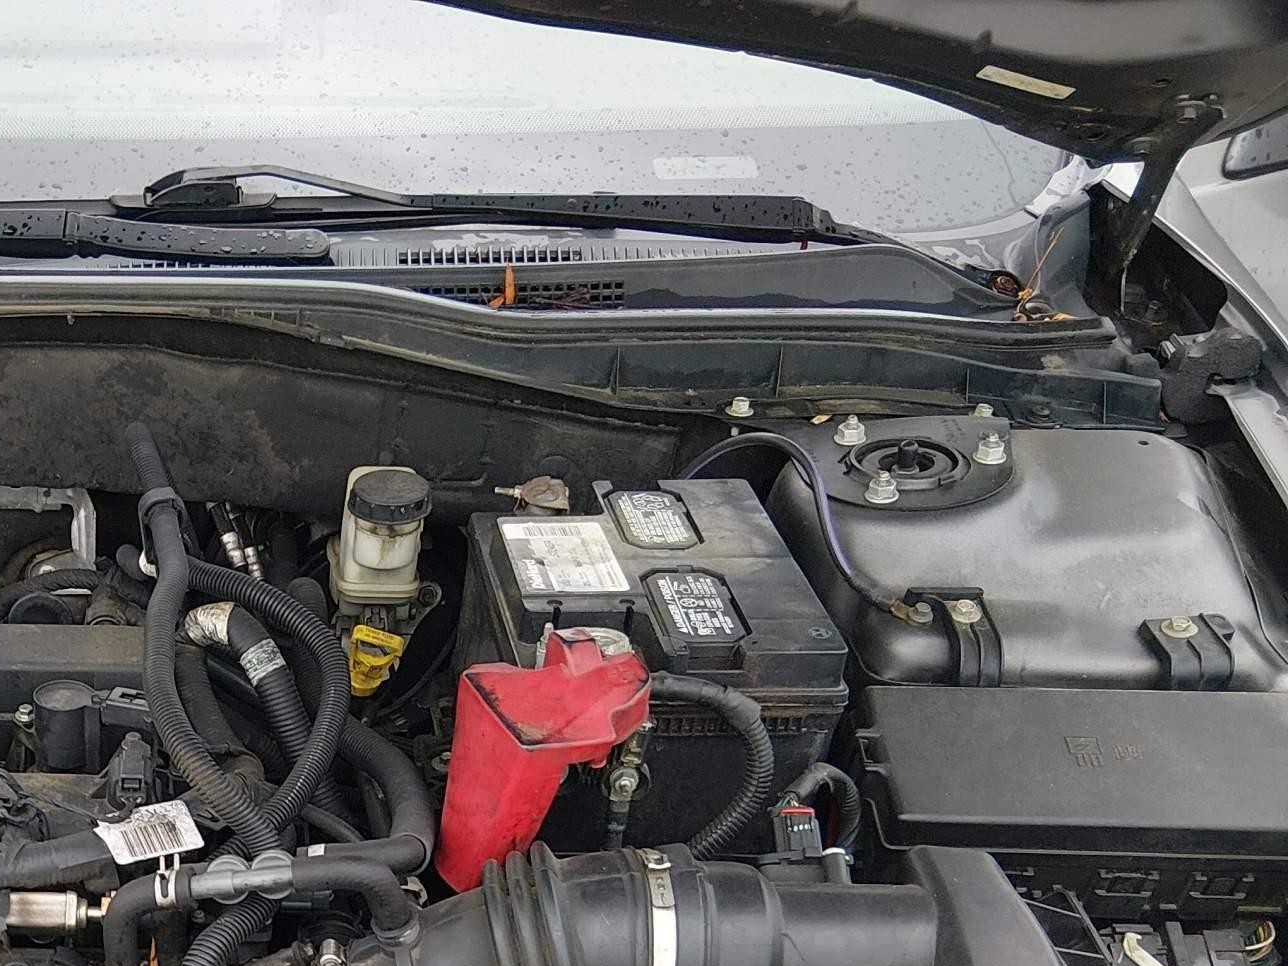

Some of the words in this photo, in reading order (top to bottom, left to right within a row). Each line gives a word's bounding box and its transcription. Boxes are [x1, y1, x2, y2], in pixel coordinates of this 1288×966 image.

[522, 559, 546, 590] DieHard
[656, 578, 674, 601] POISON
[667, 604, 685, 629] DANGER
